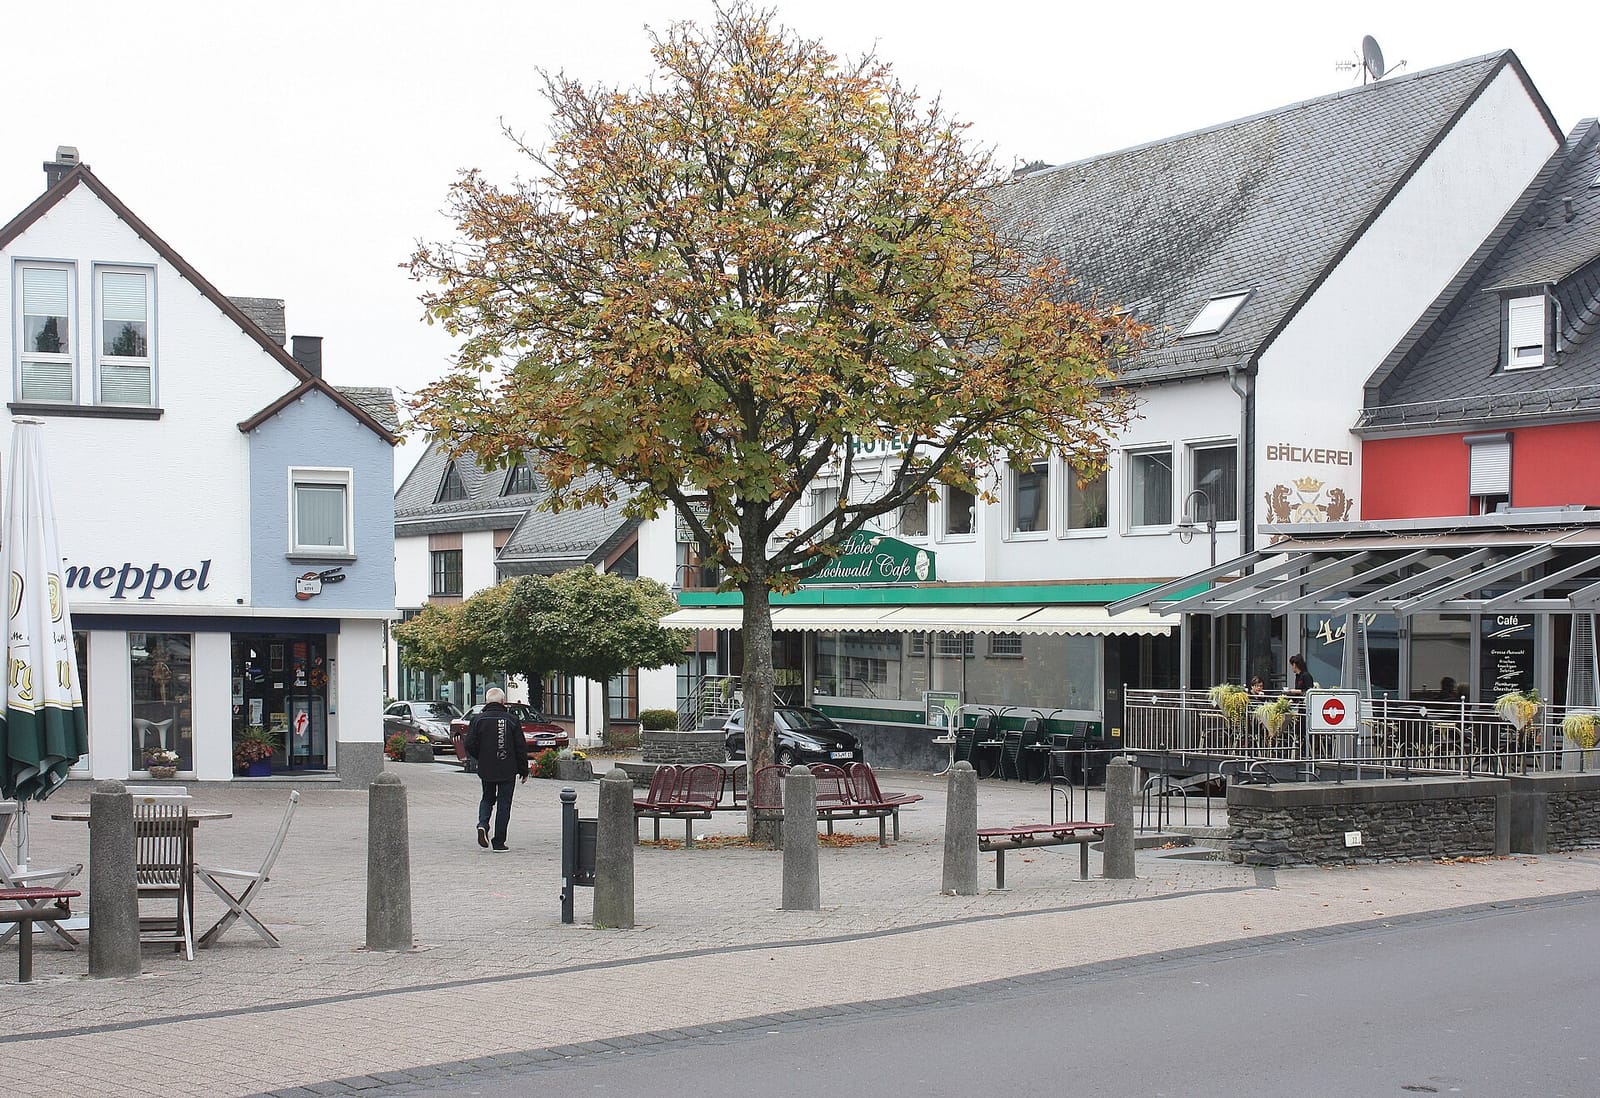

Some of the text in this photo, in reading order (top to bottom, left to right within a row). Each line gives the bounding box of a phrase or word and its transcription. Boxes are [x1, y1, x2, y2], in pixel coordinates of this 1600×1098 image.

[1266, 442, 1353, 466] BÄCKEREI
[62, 557, 212, 600] neppel
[875, 553, 912, 583] Cafe
[1496, 615, 1519, 626] Café
[497, 719, 505, 749] KRAMES
